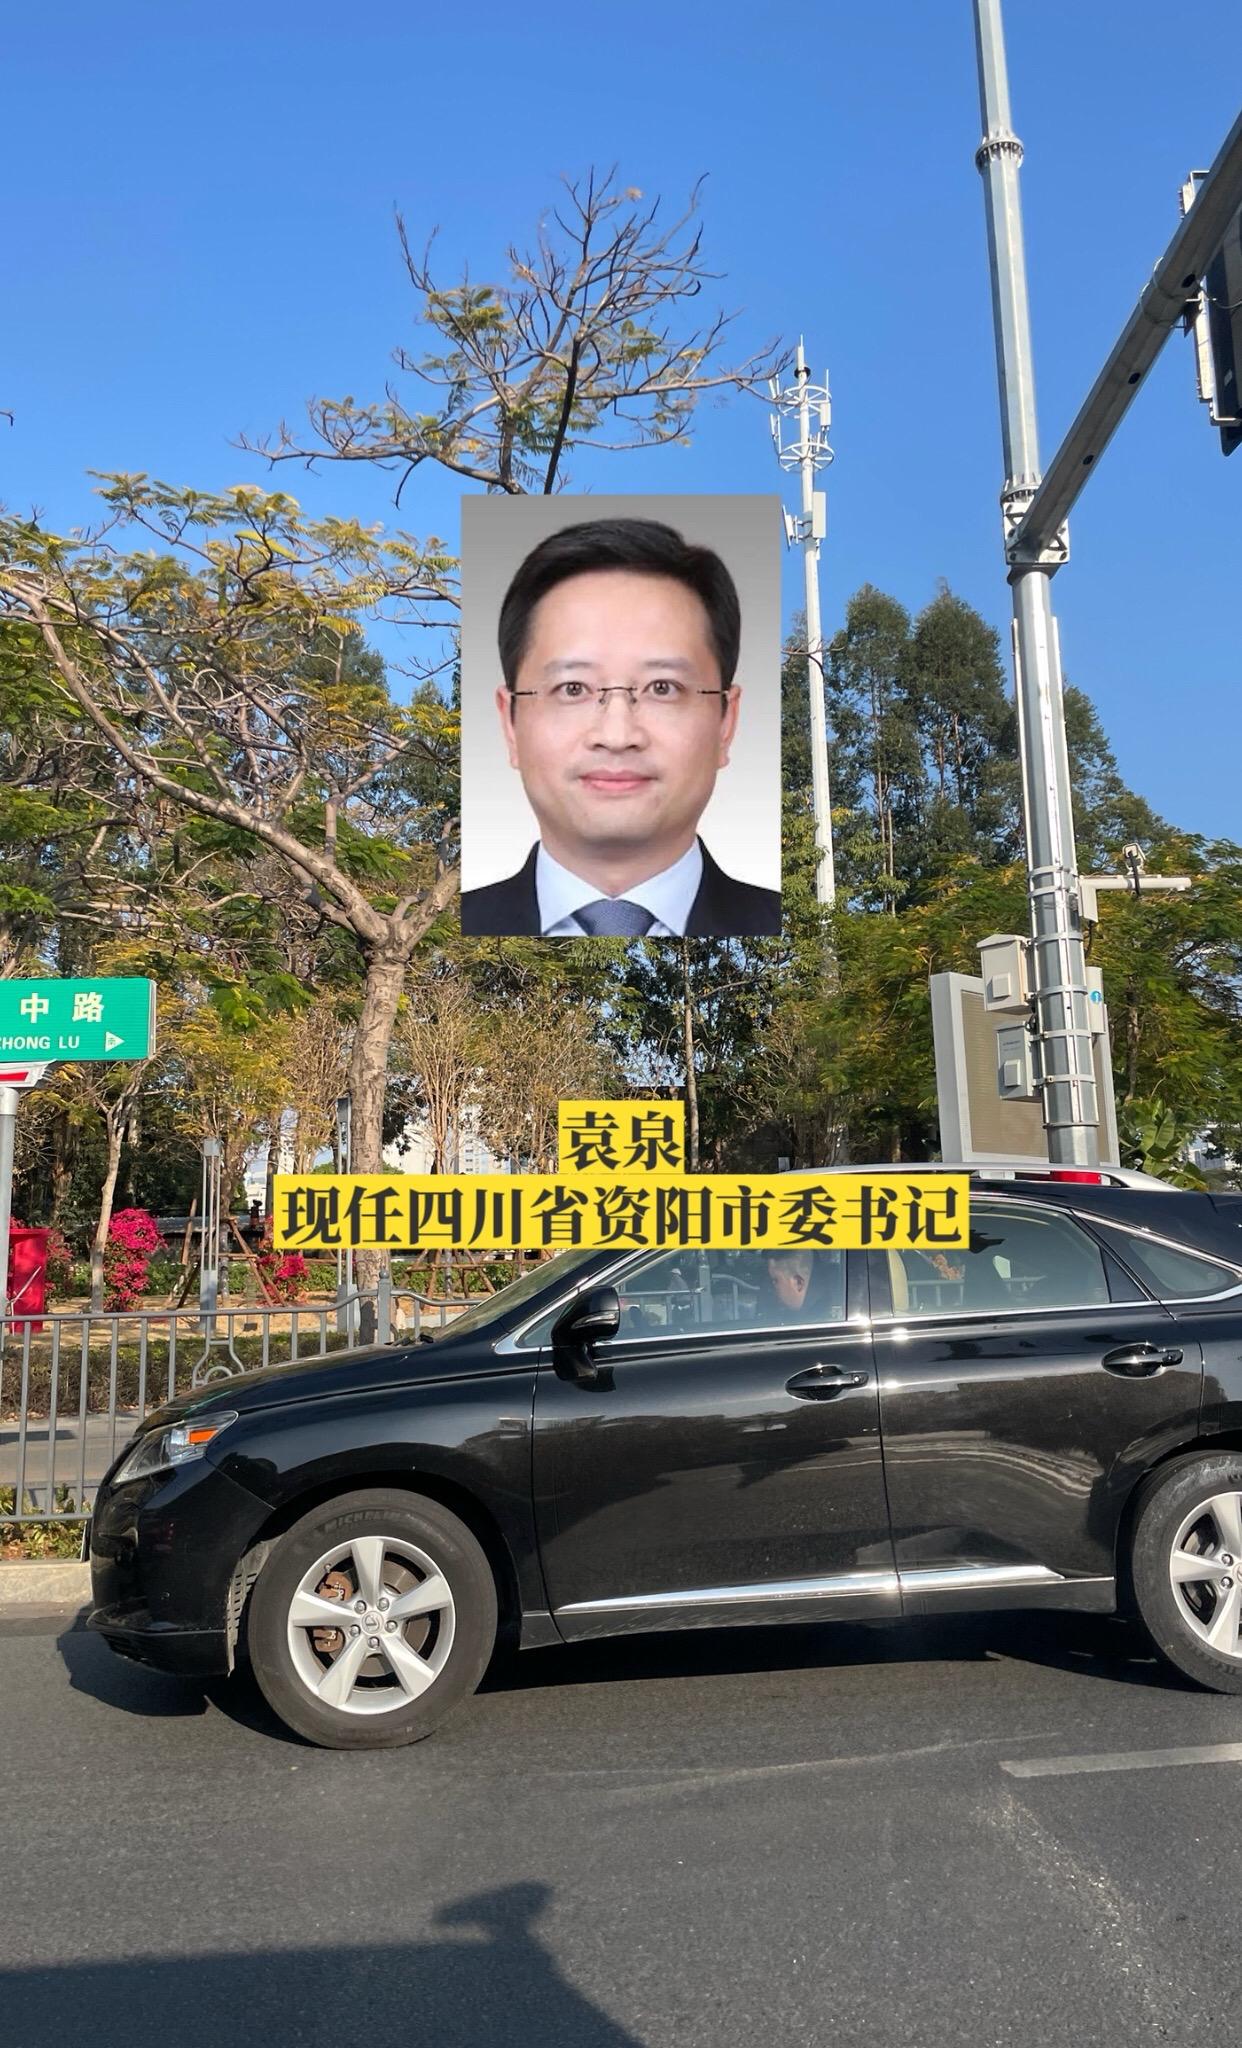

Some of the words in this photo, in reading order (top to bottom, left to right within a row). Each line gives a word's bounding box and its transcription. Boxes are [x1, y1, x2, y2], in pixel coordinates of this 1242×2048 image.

[20, 992, 104, 1023] 中路
[0, 1036, 51, 1050] HONG
[58, 1036, 80, 1049] LU
